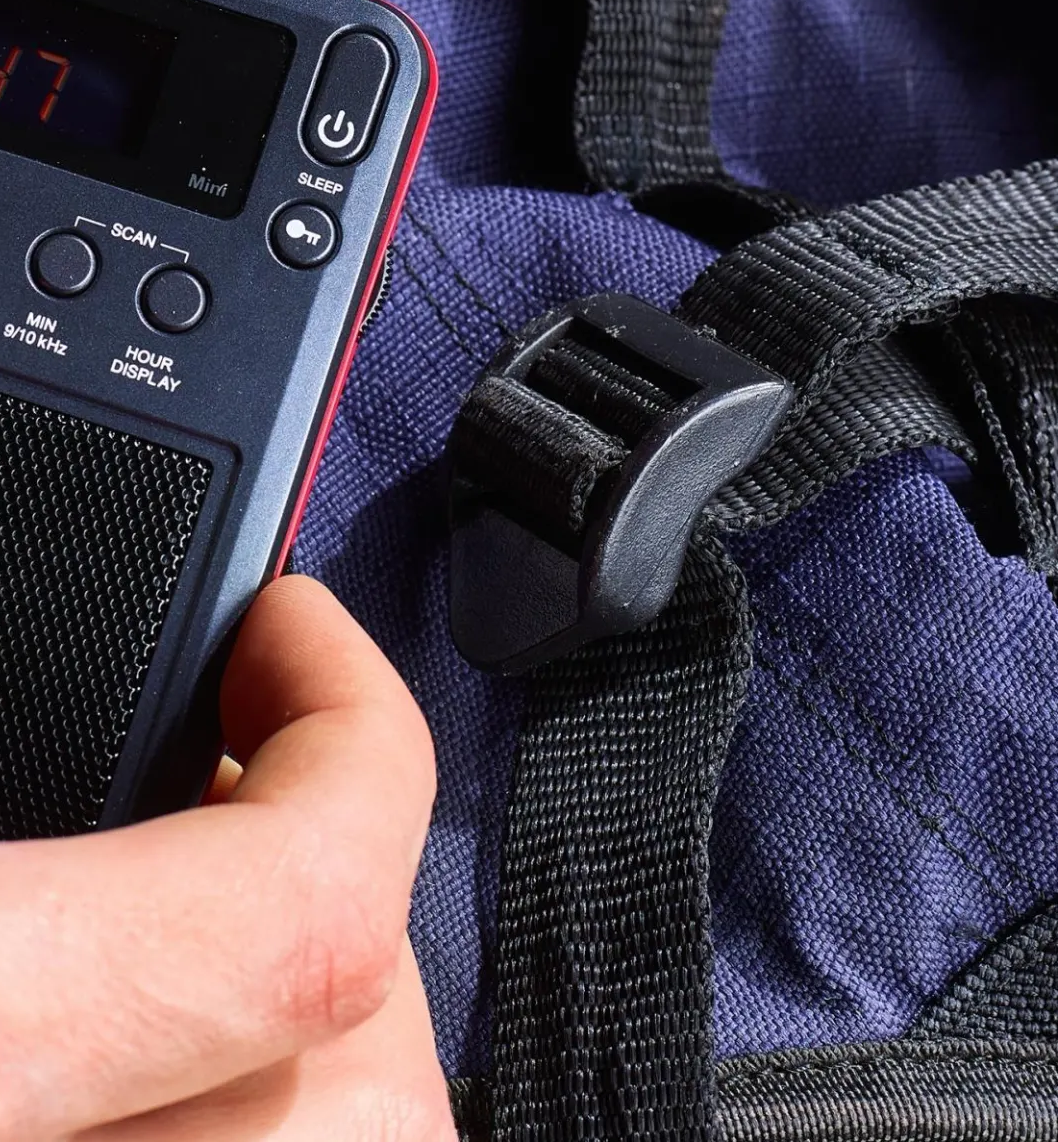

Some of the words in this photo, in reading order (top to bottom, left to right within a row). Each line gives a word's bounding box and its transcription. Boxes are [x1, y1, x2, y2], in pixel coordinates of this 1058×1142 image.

[297, 172, 344, 195] SLEEP
[110, 222, 158, 249] SCAN
[26, 311, 58, 333] MIN
[3, 324, 36, 346] 9/10
[37, 334, 69, 356] kHz
[125, 345, 174, 372] HOUR
[110, 359, 182, 393] DISPLAY
